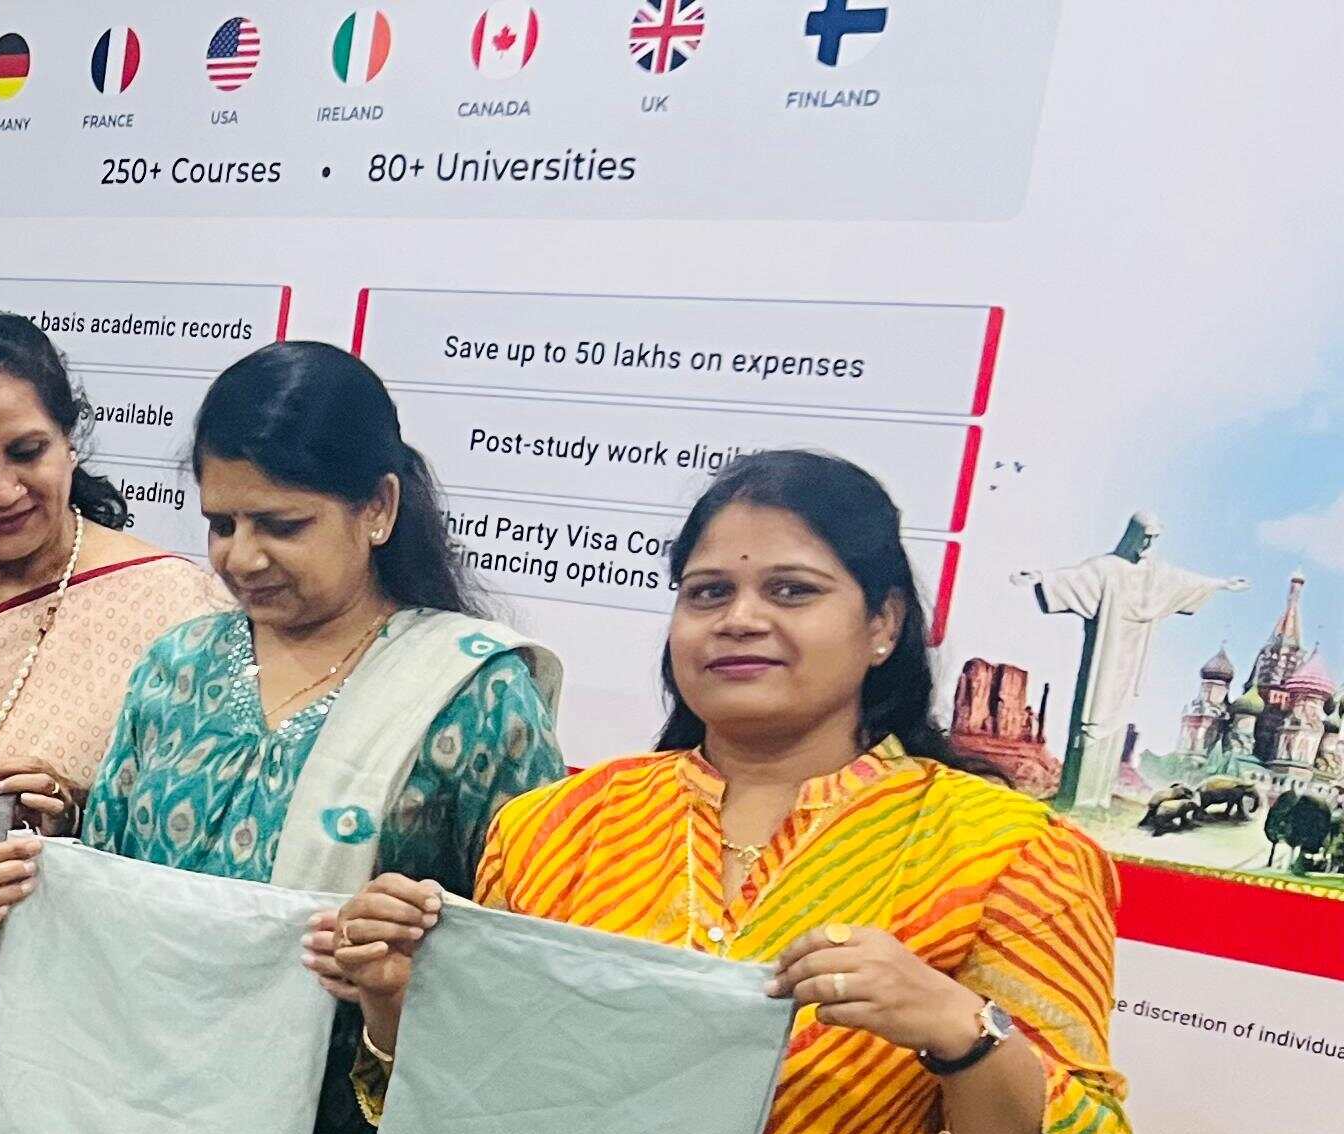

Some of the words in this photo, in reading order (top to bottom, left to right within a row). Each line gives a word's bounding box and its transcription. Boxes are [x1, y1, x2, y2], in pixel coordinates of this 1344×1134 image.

[316, 105, 384, 122] IRELAND
[457, 100, 531, 118] CANADA
[641, 95, 670, 113] UK
[785, 89, 881, 110] FINLAND
[82, 113, 135, 129] FRANCE
[210, 110, 239, 125] USA
[100, 158, 162, 185] 250+
[171, 157, 282, 184] Courses
[368, 153, 425, 182] 80+
[436, 148, 637, 183] Universities
[40, 310, 85, 333] basis
[90, 314, 176, 337] academic
[181, 318, 253, 341] records
[444, 335, 499, 360] Save
[507, 342, 536, 367] up
[543, 342, 567, 365] to
[575, 341, 605, 366] 50
[613, 342, 681, 370] lakhs
[690, 351, 722, 372] on
[732, 353, 865, 381] expenses
[94, 402, 174, 427] available
[469, 428, 599, 465] Post-study
[607, 440, 668, 467] work
[120, 478, 185, 511] leading
[442, 510, 489, 537] hird
[496, 517, 559, 551] Party
[568, 524, 618, 550] Visa
[449, 543, 558, 583] inancing
[566, 561, 659, 590] options
[1133, 1000, 1227, 1034] discretion
[1233, 1022, 1256, 1039] of
